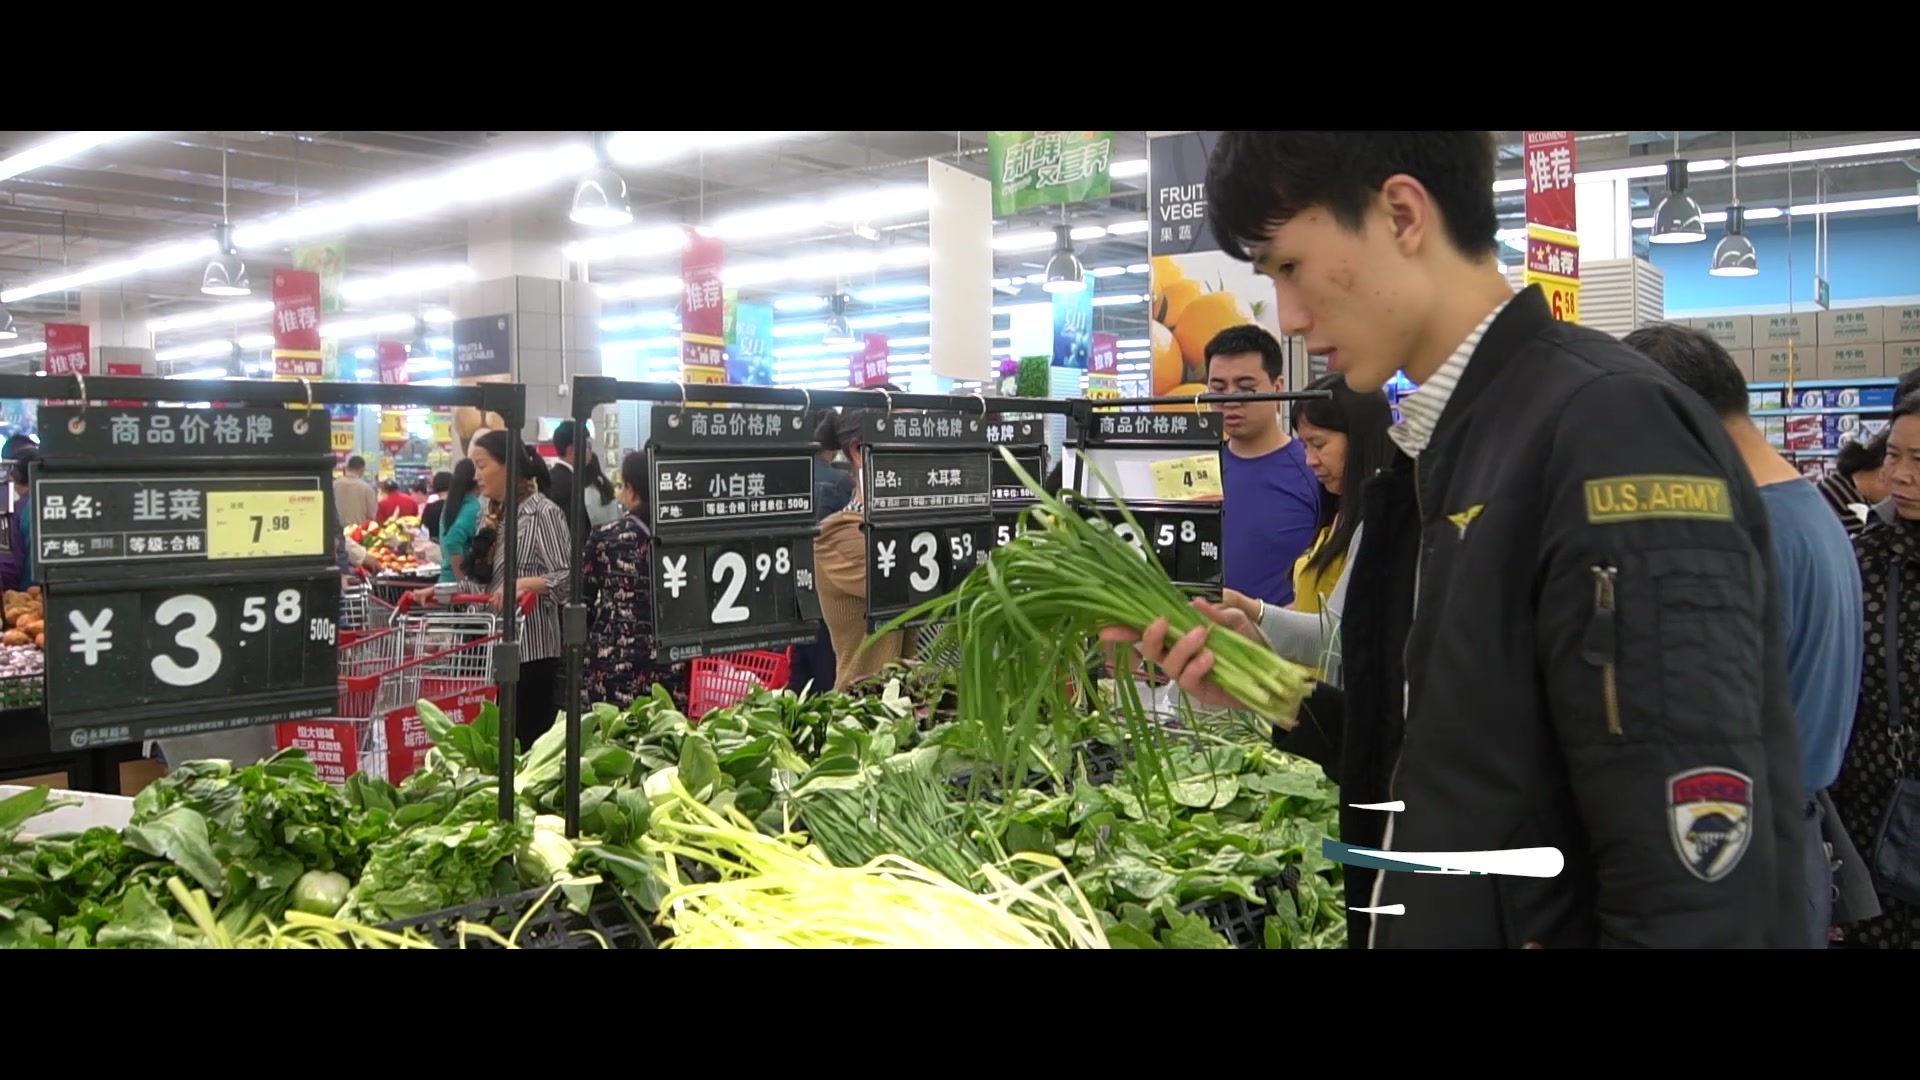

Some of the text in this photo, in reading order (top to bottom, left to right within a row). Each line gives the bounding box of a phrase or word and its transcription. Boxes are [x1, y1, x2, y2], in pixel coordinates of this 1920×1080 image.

[1529, 147, 1573, 194] 推荐
[1160, 201, 1208, 221] VEGE
[1548, 251, 1574, 275] 推荐
[685, 280, 720, 312] 推荐
[278, 306, 317, 333] 推荐
[110, 414, 274, 445] 商品价格牌
[691, 413, 782, 437] 商品价格牌
[893, 416, 963, 438] 商品价格牌
[986, 424, 1015, 443] 格牌
[1099, 415, 1188, 434] 商品价格牌
[659, 471, 765, 497] 品名: 小白菜
[875, 468, 962, 488] 品名: 木耳菜
[43, 488, 201, 520] 品名: 韭菜
[660, 505, 683, 519] 产地:
[249, 514, 290, 544] 7.98
[43, 538, 85, 557] 产地:
[129, 535, 201, 553] 等级:合格
[1201, 541, 1219, 561] 500g
[309, 617, 336, 646] 500g
